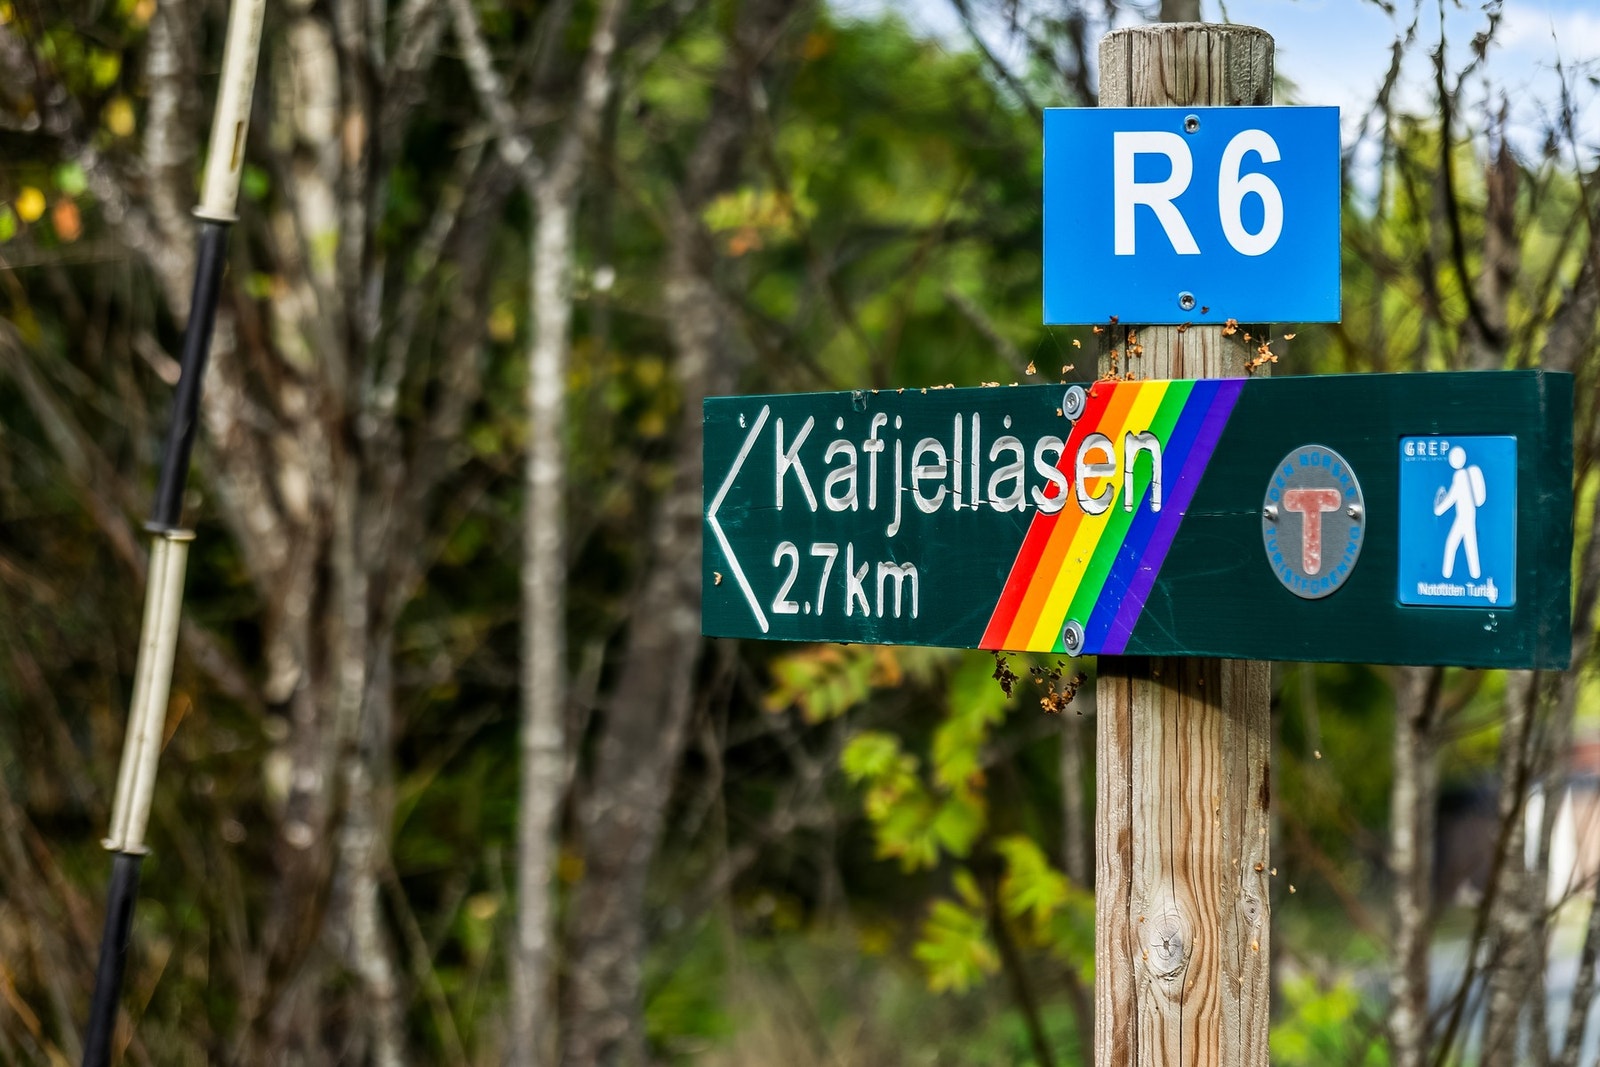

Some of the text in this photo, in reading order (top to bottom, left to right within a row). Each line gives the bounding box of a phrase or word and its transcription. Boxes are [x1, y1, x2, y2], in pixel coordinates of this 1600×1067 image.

[776, 411, 1162, 538] Kåfjellåsen
[1404, 440, 1450, 457] GREP
[1268, 462, 1295, 503] DEN
[1284, 488, 1341, 575] T
